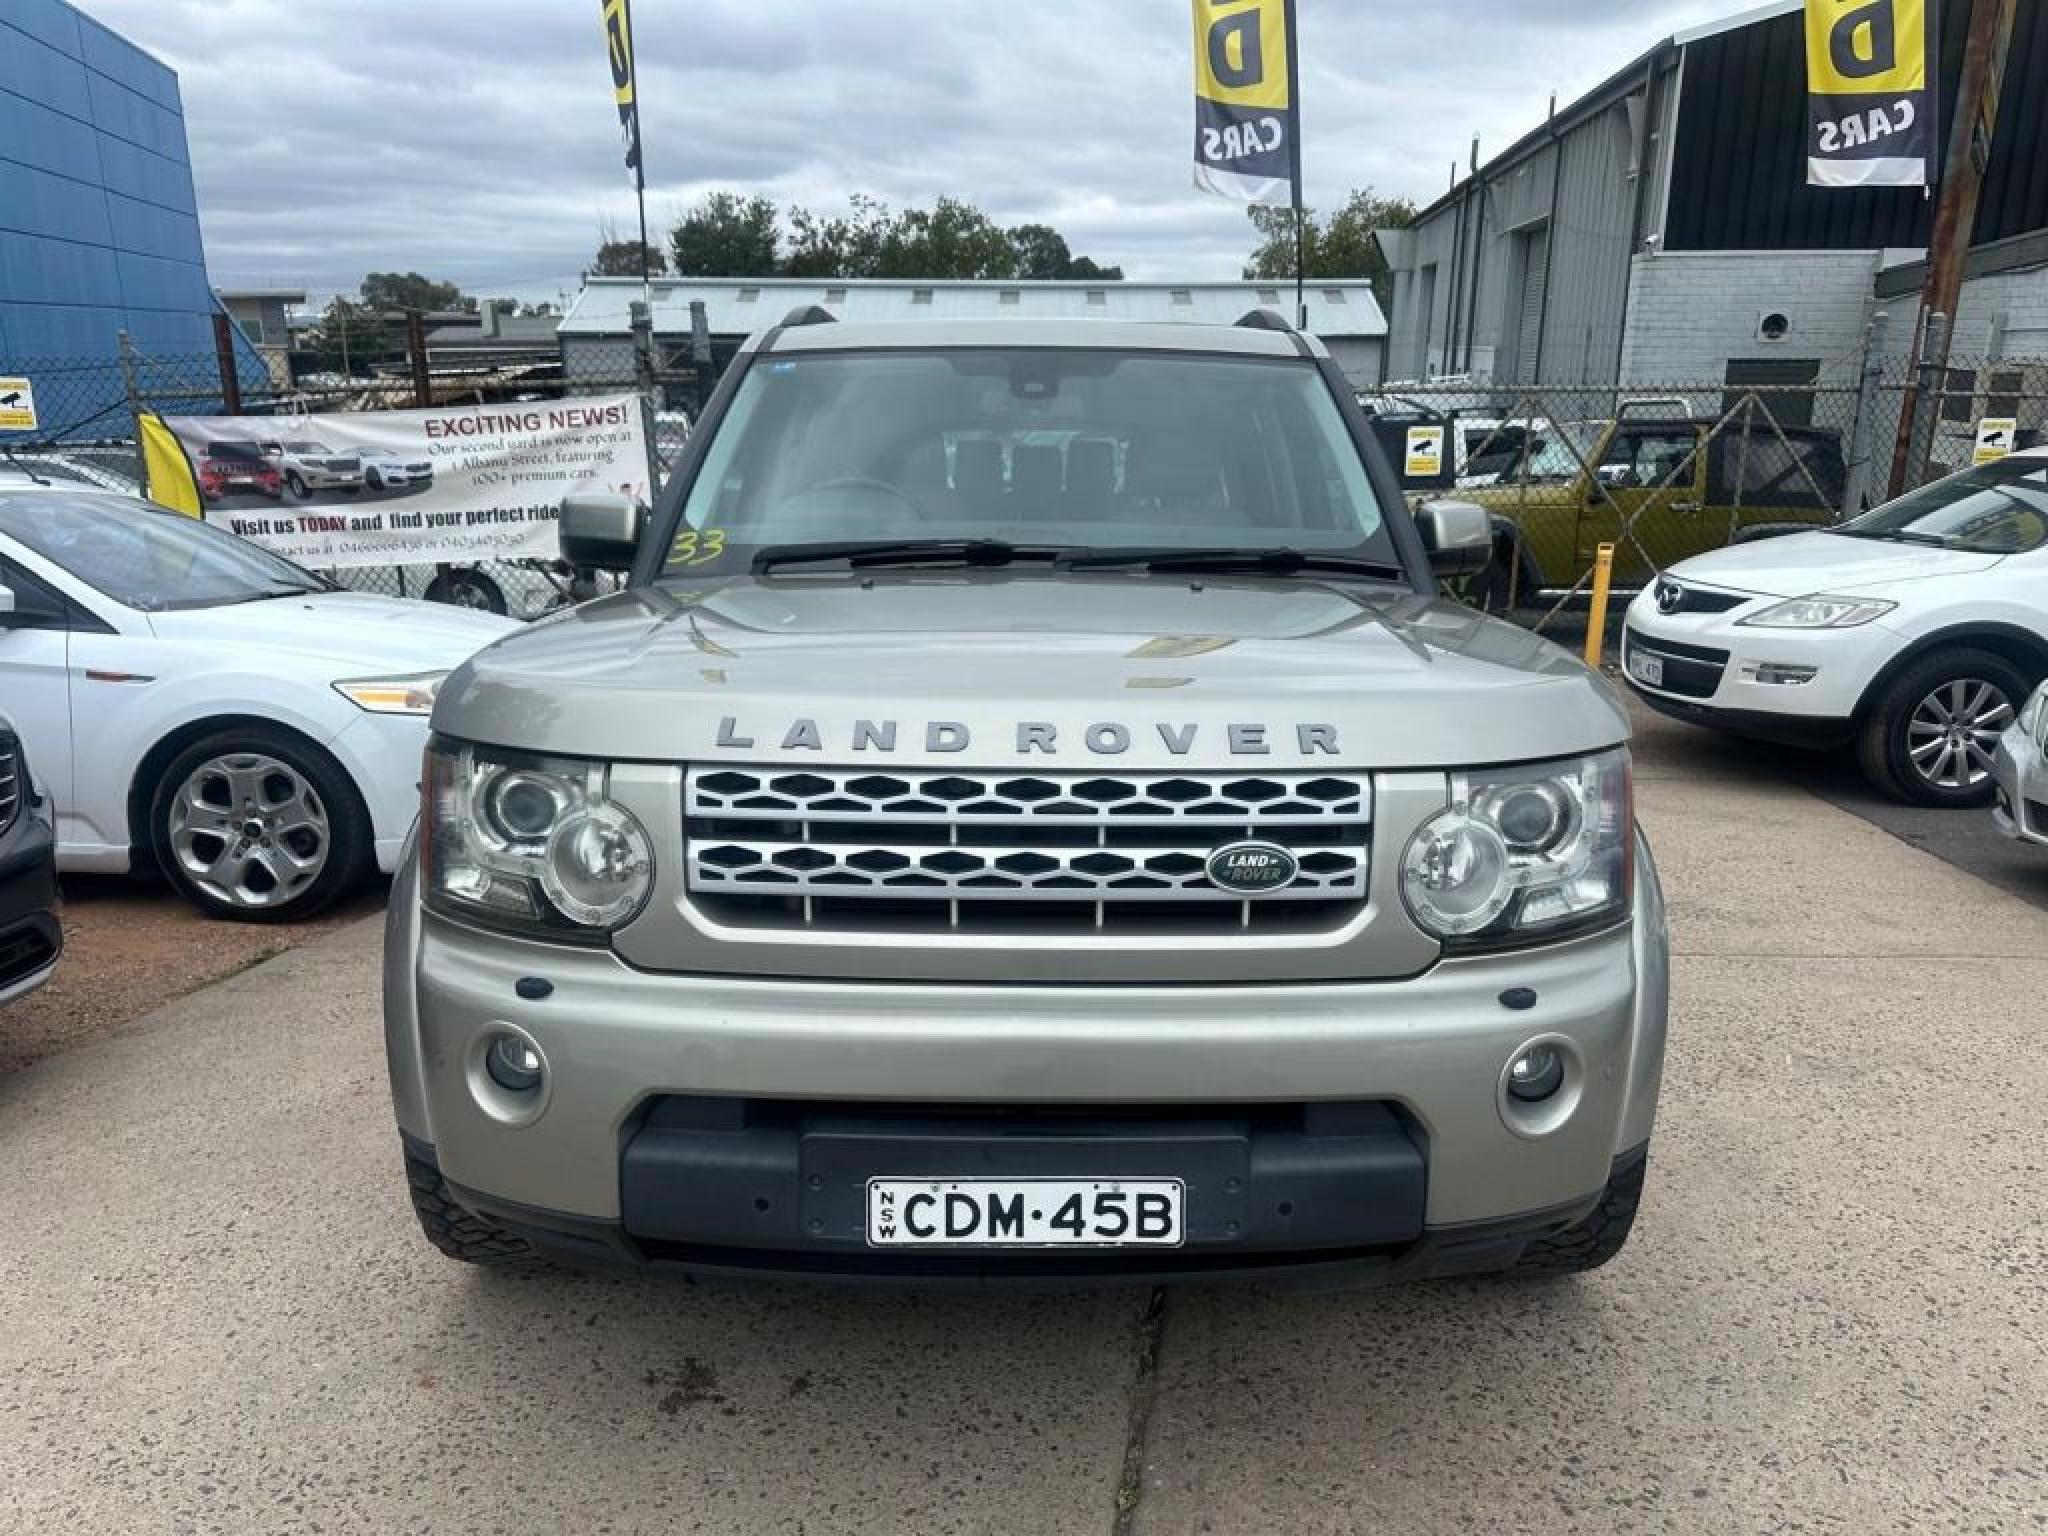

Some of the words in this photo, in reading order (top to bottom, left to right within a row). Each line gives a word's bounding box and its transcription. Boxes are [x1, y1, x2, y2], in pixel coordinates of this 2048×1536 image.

[425, 412, 541, 438] EXCITING
[548, 405, 628, 429] NEWS!
[428, 442, 456, 456] Our
[461, 437, 504, 453] second
[555, 433, 582, 446] now
[586, 433, 616, 447] open
[620, 430, 631, 442] at
[462, 456, 508, 473] Albany
[556, 448, 614, 465] featuring
[511, 469, 566, 486] premium
[230, 519, 271, 536] Visit
[273, 519, 295, 535] us
[296, 516, 346, 533] TODAY
[351, 514, 383, 531] and
[389, 511, 422, 528] find
[425, 511, 463, 529] your
[465, 506, 525, 527] perfect
[668, 530, 724, 565] 33
[716, 716, 972, 753] LAND
[1015, 721, 1341, 755] ROVER
